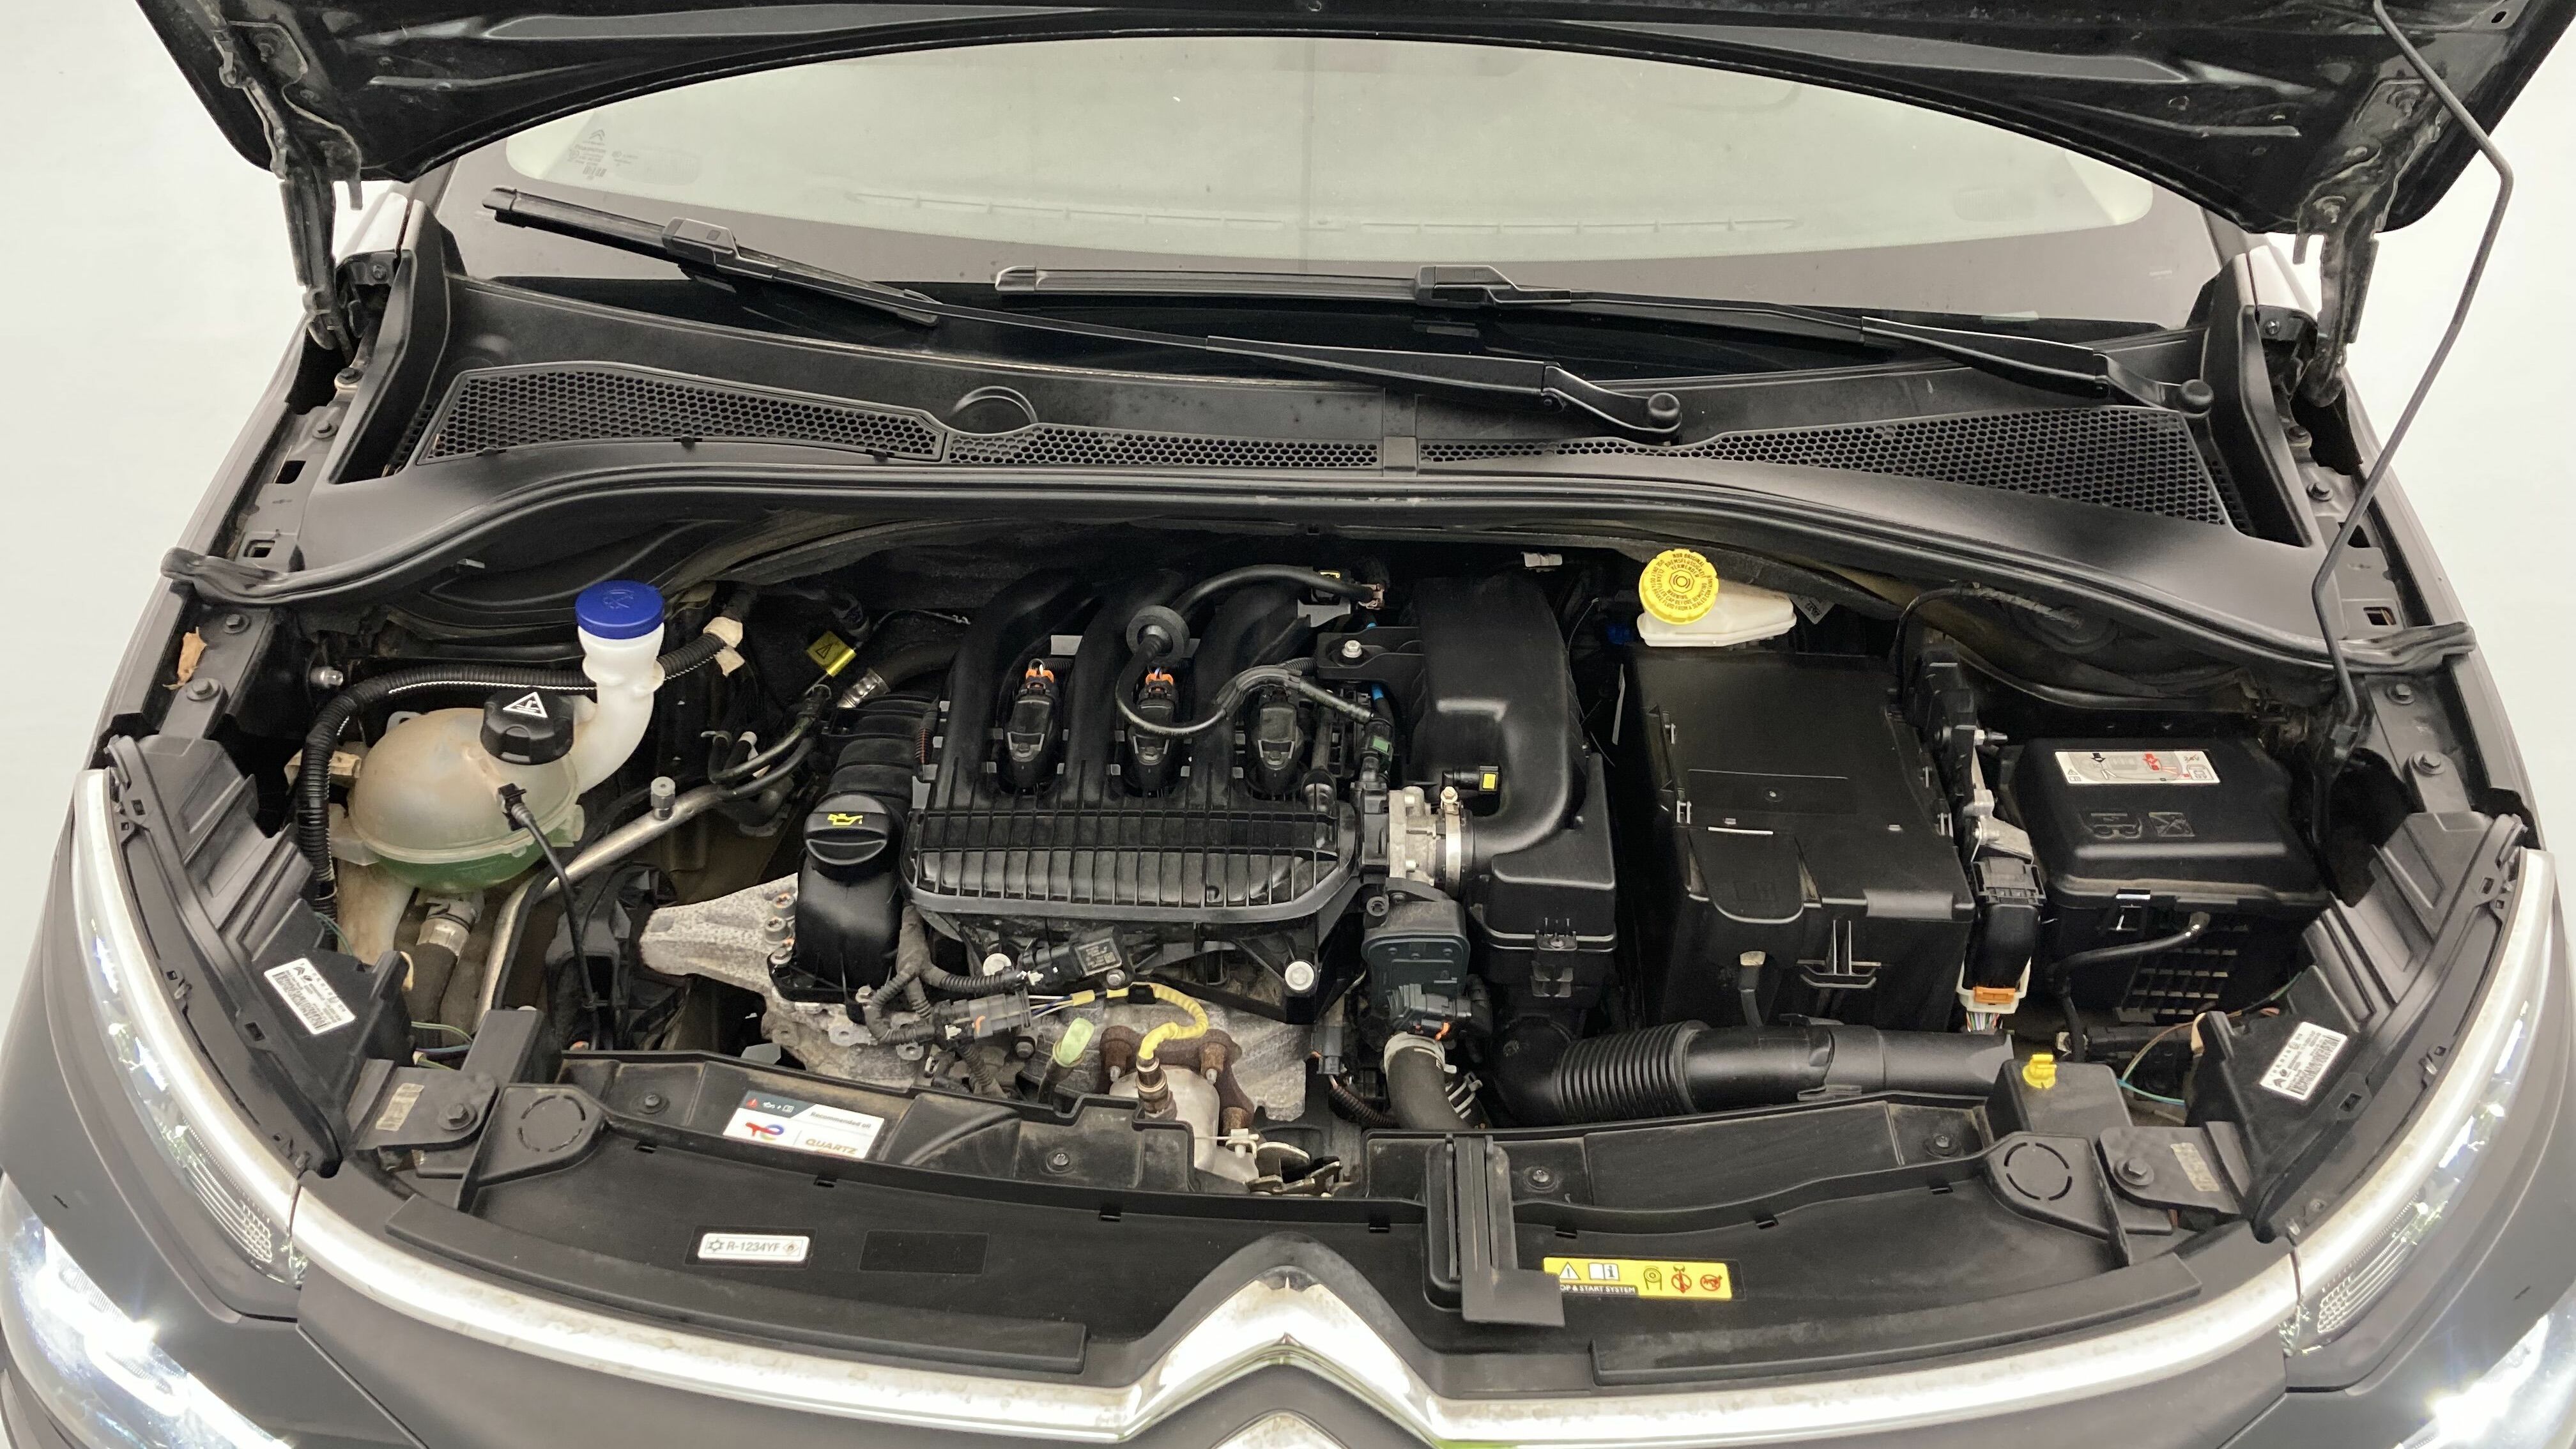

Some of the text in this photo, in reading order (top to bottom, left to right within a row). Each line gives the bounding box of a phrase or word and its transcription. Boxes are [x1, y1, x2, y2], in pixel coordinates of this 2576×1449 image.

[810, 1111, 862, 1126] Recommended
[805, 1138, 859, 1154] QUARTZ
[726, 1241, 781, 1252] R-1234YF
